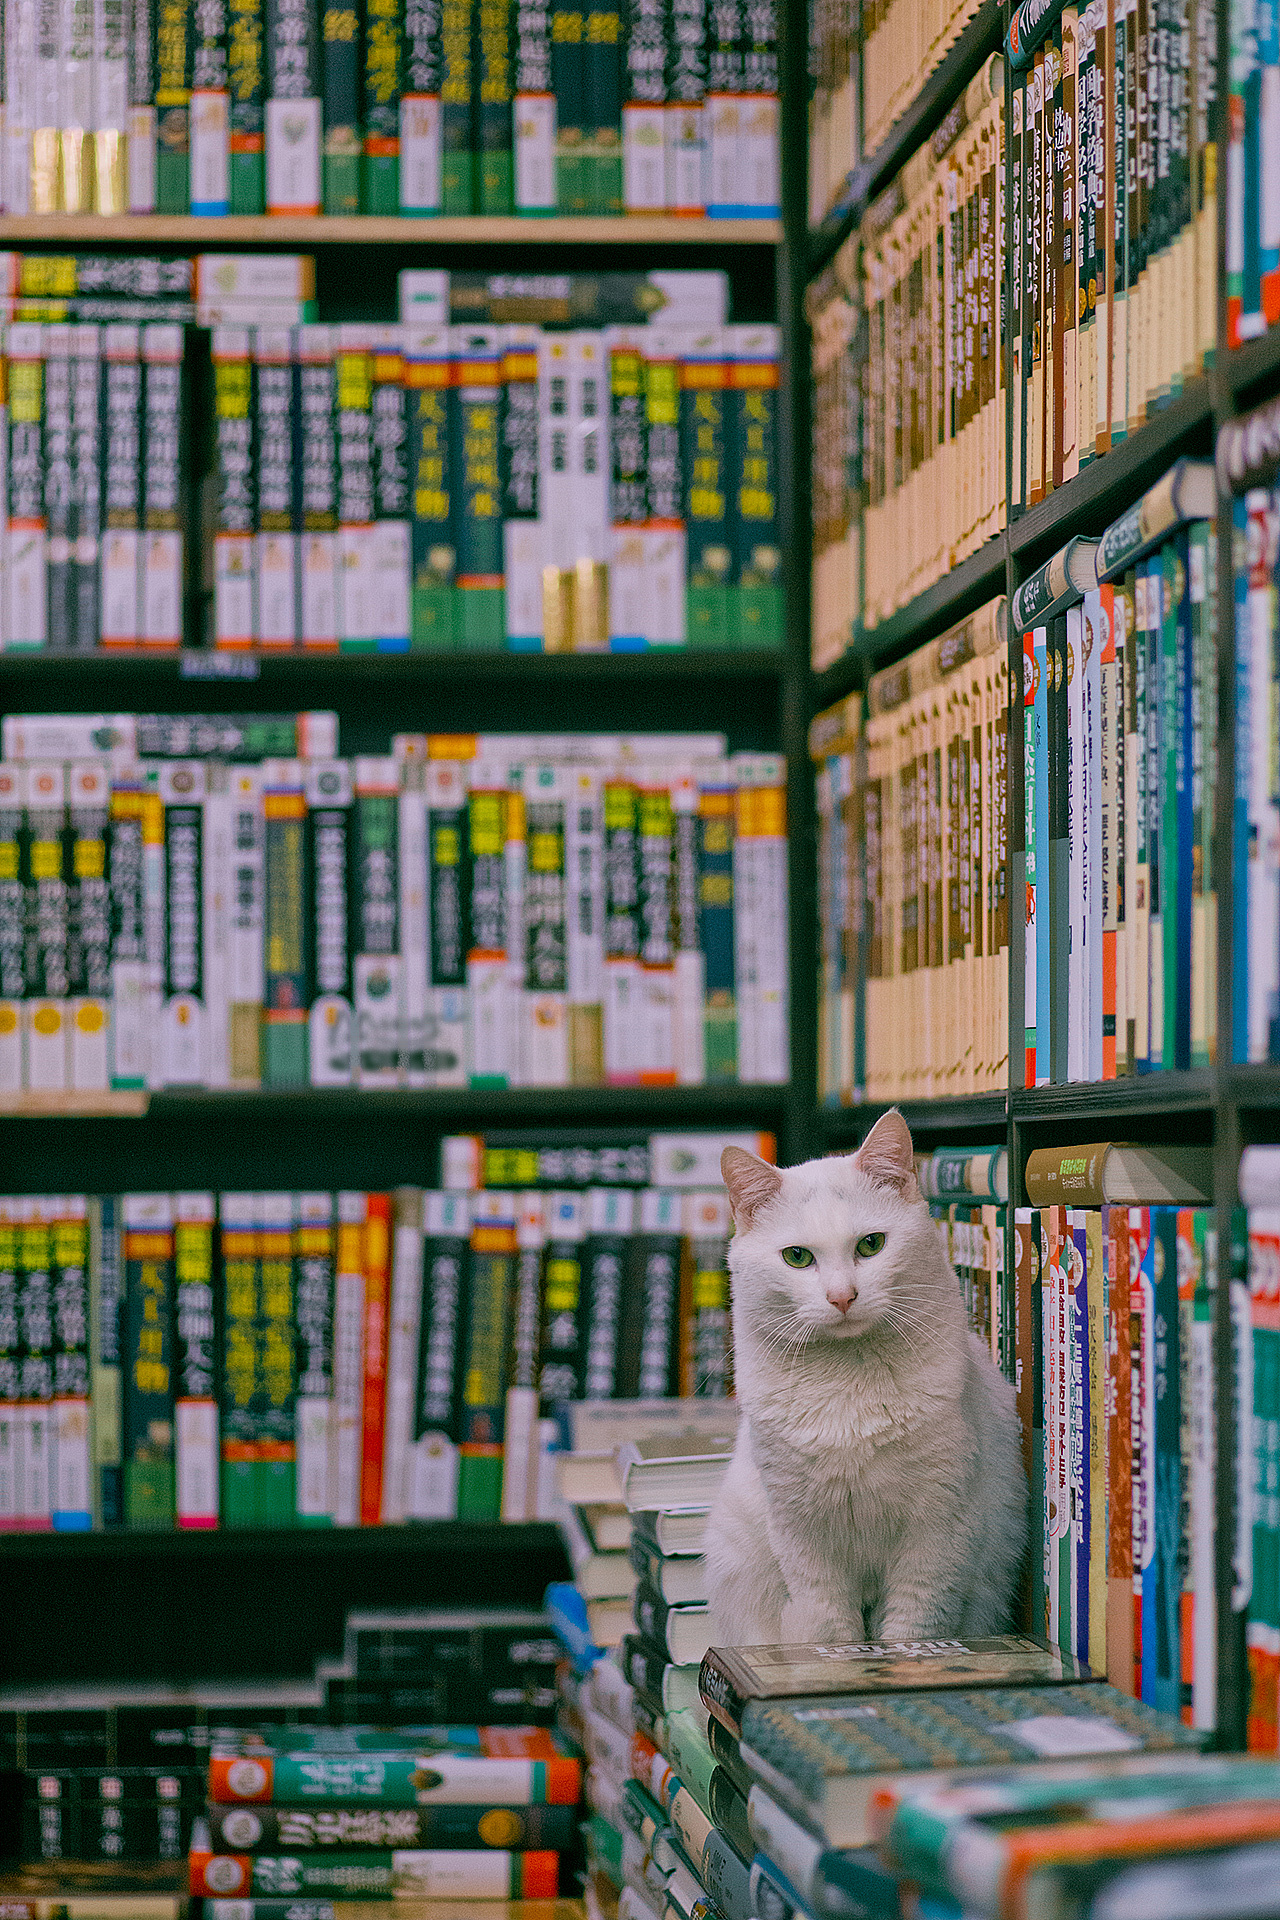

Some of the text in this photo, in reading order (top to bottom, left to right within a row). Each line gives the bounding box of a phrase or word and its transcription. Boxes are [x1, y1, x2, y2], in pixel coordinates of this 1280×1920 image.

[1054, 107, 1063, 172] 枕边书
[1063, 113, 1073, 221] 纳兰词
[1095, 68, 1105, 209] 世界通史
